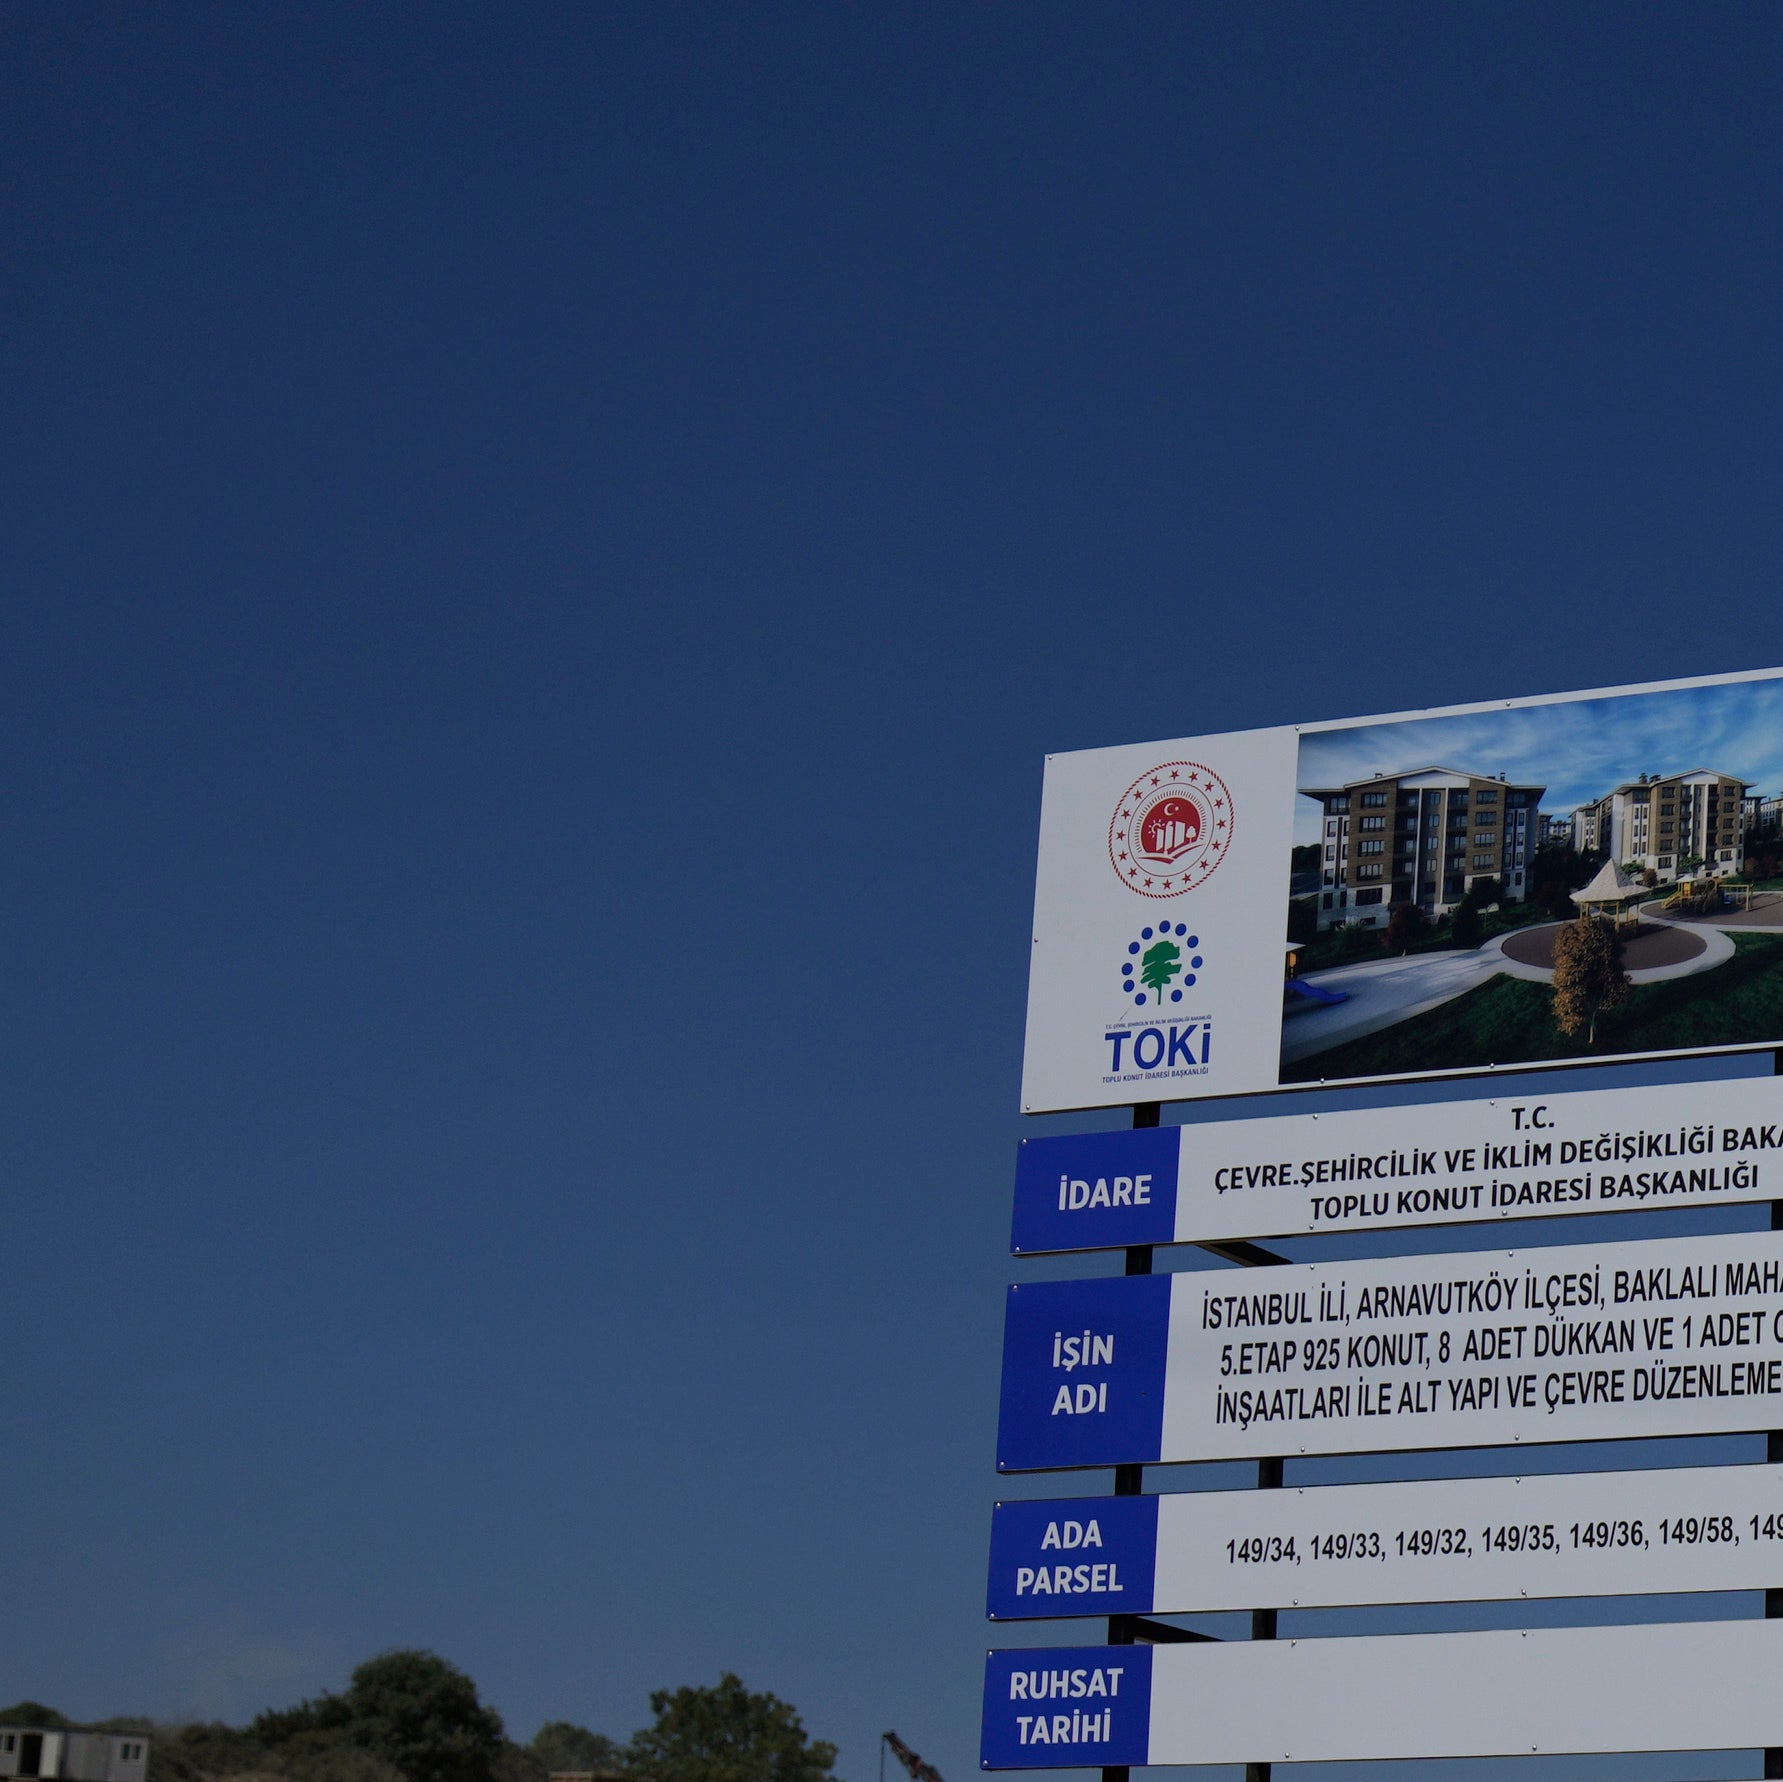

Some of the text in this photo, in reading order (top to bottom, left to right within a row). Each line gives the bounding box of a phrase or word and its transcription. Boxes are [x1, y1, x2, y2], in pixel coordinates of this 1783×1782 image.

[1145, 1070, 1169, 1080] İDARESİ
[1172, 1067, 1208, 1078] BAŞKANLIĞI
[1512, 1106, 1554, 1130] T.C.
[1445, 1149, 1475, 1172] VE
[1484, 1140, 1551, 1170] İKLİM
[1561, 1125, 1713, 1164] DEĞİŞİKLİĞİ
[1059, 1175, 1151, 1210] İDARE
[1311, 1161, 1757, 1220] TOPLU KONUT İDARESİ BAŞKANLIĞI
[1203, 1290, 1312, 1329] İSTANBUL
[1320, 1281, 1349, 1326] İLİ,
[1357, 1271, 1518, 1319] ARNAVUTKÖY
[1525, 1264, 1604, 1321] İLÇESİ,
[1614, 1265, 1717, 1303] BAKLALI
[1053, 1330, 1113, 1371] İŞİN
[1221, 1341, 1296, 1376] 5.ETAP
[1304, 1338, 1340, 1371] 925
[1348, 1332, 1429, 1370] KONUT,
[1439, 1331, 1450, 1363] 8
[1463, 1326, 1527, 1361] ADET
[1535, 1316, 1634, 1357] DÜKKAN
[1643, 1317, 1673, 1350] VE
[1683, 1316, 1691, 1348] 1
[1700, 1312, 1766, 1347] ADET
[1052, 1383, 1107, 1415] ADI
[1217, 1385, 1350, 1430] İNŞAATLARI
[1358, 1376, 1392, 1416] İLE
[1398, 1380, 1441, 1414] ALT
[1448, 1377, 1499, 1411] YAPI
[1507, 1375, 1536, 1407] VE
[1545, 1370, 1624, 1414] ÇEVRE
[1041, 1520, 1102, 1549] ADA
[1227, 1537, 1300, 1565] 149/34,
[1311, 1533, 1385, 1561] 149/33,
[1396, 1529, 1471, 1557] 149/32,
[1483, 1525, 1559, 1554] 149/35,
[1571, 1521, 1648, 1550] 149/36,
[1660, 1516, 1739, 1546] 149/58,
[1017, 1564, 1123, 1595] PARSEL
[1010, 1668, 1123, 1699] RUHSAT
[1017, 1708, 1110, 1744] TARİHİ
